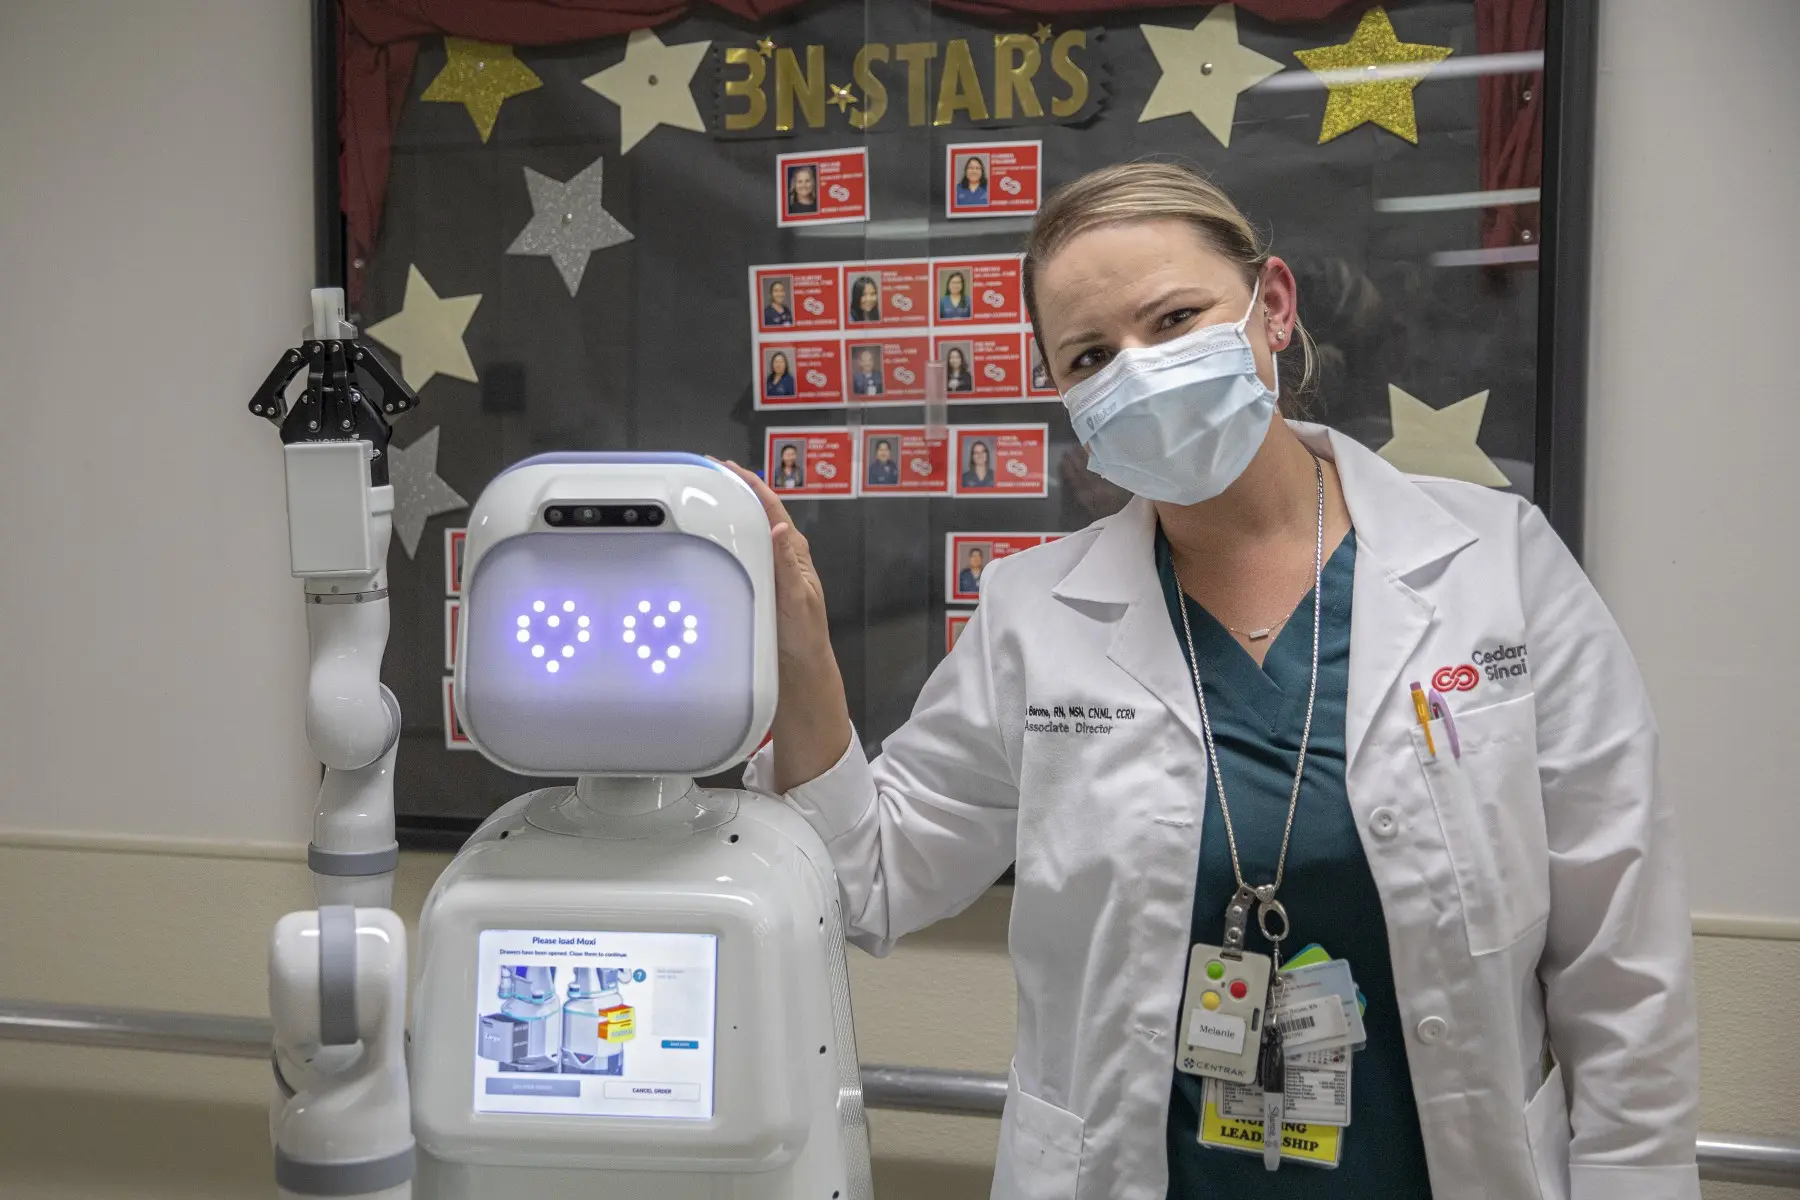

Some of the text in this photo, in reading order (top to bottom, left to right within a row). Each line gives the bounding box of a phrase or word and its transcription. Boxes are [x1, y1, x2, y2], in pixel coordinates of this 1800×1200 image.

[725, 29, 1089, 131] 3N STARS
[1485, 659, 1527, 681] Sinai
[1116, 708, 1136, 720] CCRN
[1025, 720, 1113, 735] Associate Director
[532, 937, 597, 946] Please load Moxi
[1200, 1024, 1235, 1039] Melanie
[1220, 1126, 1319, 1152] LEADSHIP
